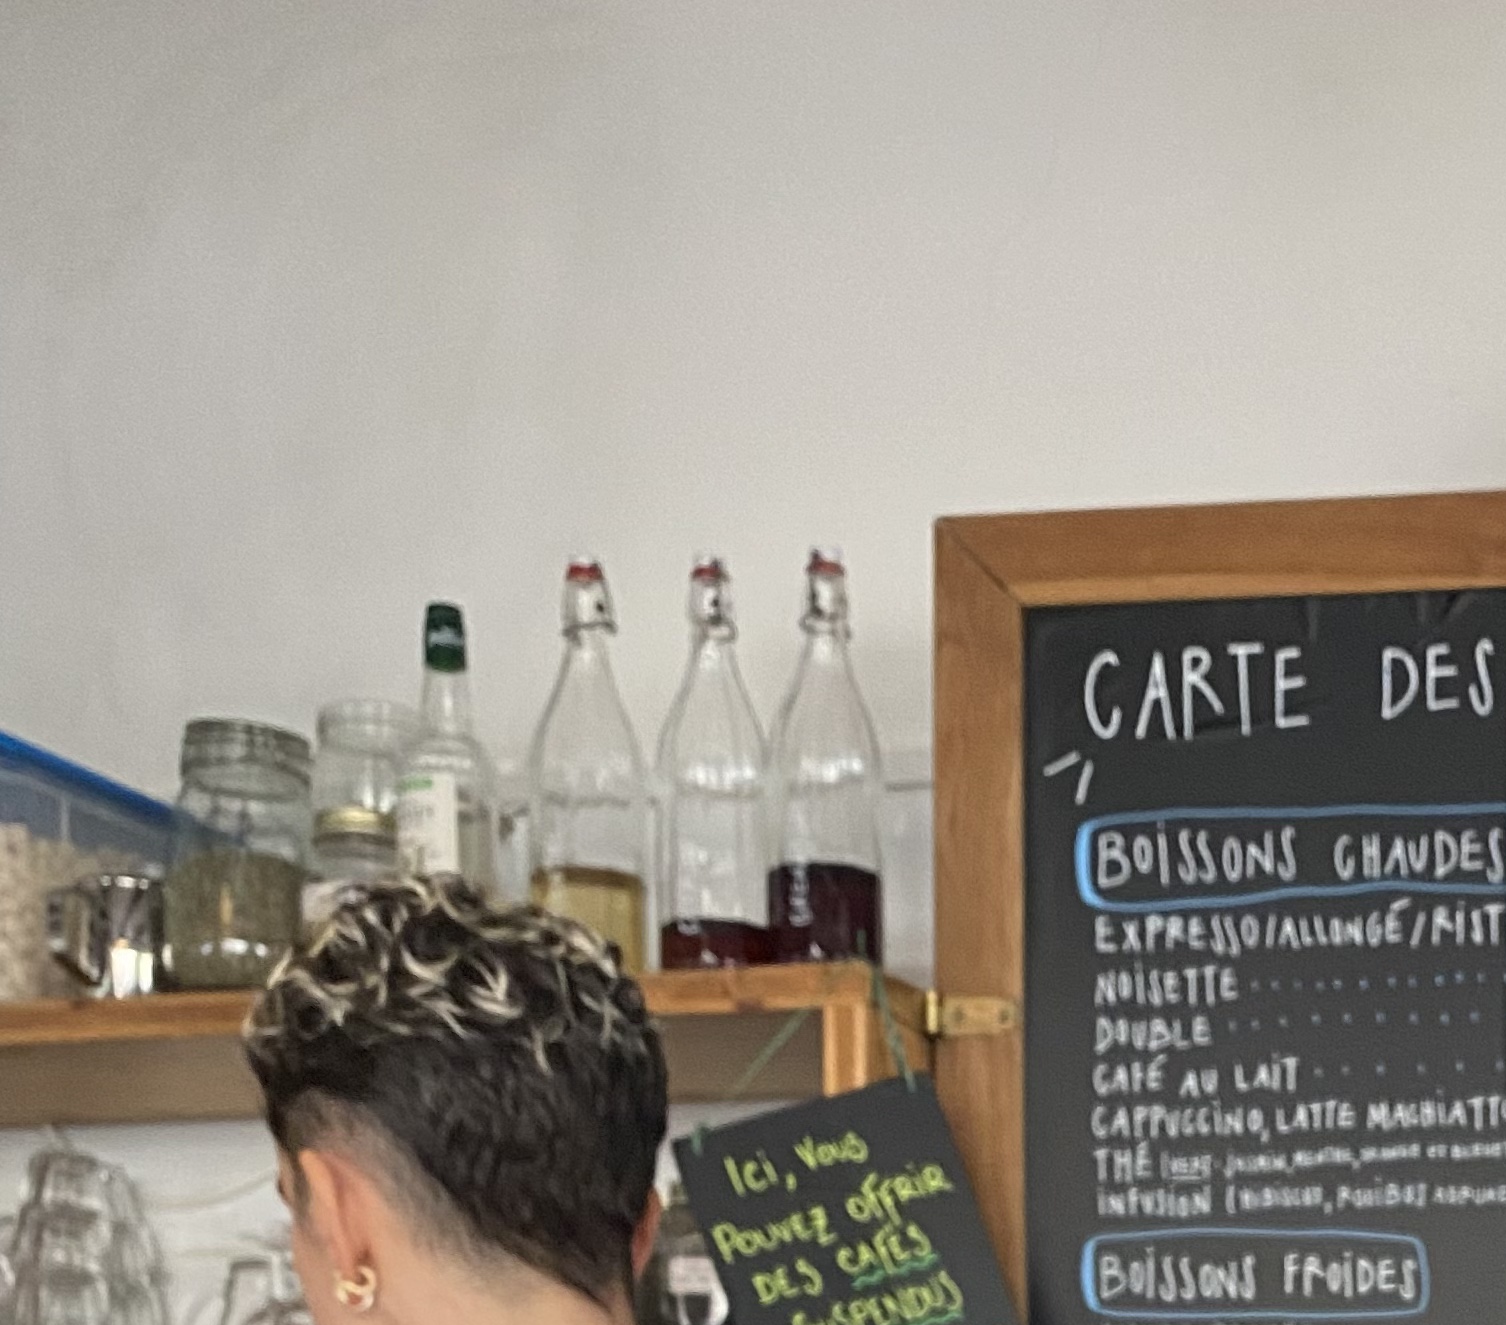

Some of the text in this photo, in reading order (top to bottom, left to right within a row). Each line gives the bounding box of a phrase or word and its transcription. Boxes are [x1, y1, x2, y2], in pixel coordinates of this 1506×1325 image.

[1084, 642, 1309, 740] CARTE
[1381, 637, 1495, 721] DES
[1098, 821, 1504, 888] BOISSONS CHAUDES
[1094, 961, 1239, 1007] NOISETTE
[1094, 1015, 1212, 1055] DOUBLE
[1092, 1054, 1168, 1097] CAFÉ
[1179, 1067, 1218, 1097] AU
[1233, 1051, 1299, 1093] LAIT
[1275, 1099, 1356, 1132] LATTE
[1093, 1140, 1152, 1184] THÉ
[752, 1259, 824, 1305] DES
[1100, 1246, 1417, 1302] BOISSONS FROIDES
